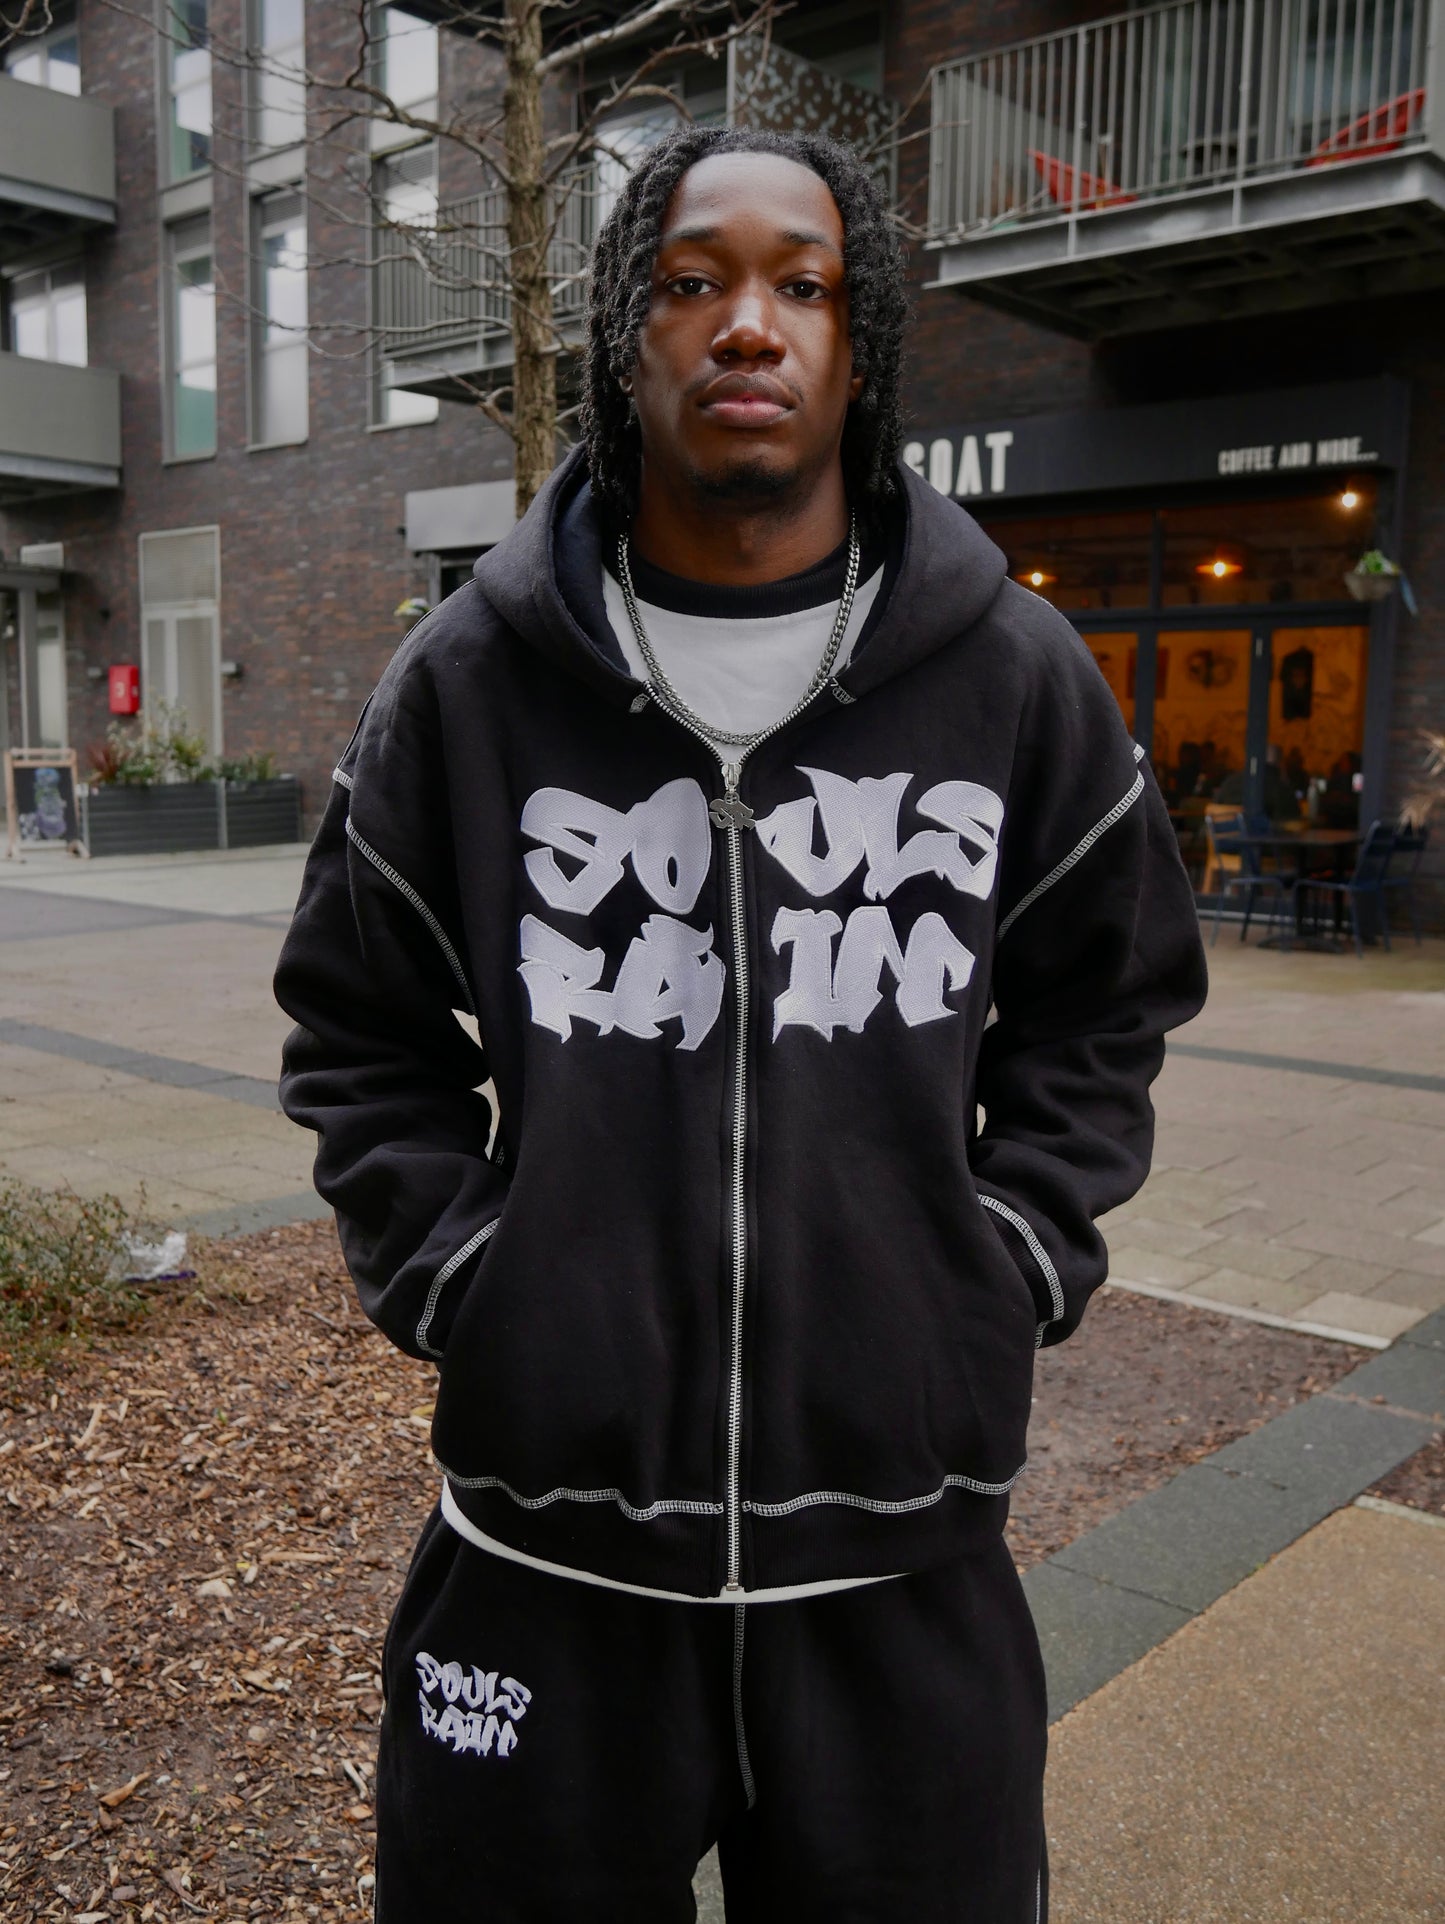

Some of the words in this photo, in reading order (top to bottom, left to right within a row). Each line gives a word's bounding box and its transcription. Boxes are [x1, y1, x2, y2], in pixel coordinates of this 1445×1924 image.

[1217, 445, 1274, 475] COFFEE
[1278, 441, 1311, 469] AND
[415, 1651, 533, 1721] SOULS
[418, 1689, 519, 1757] RAIN
